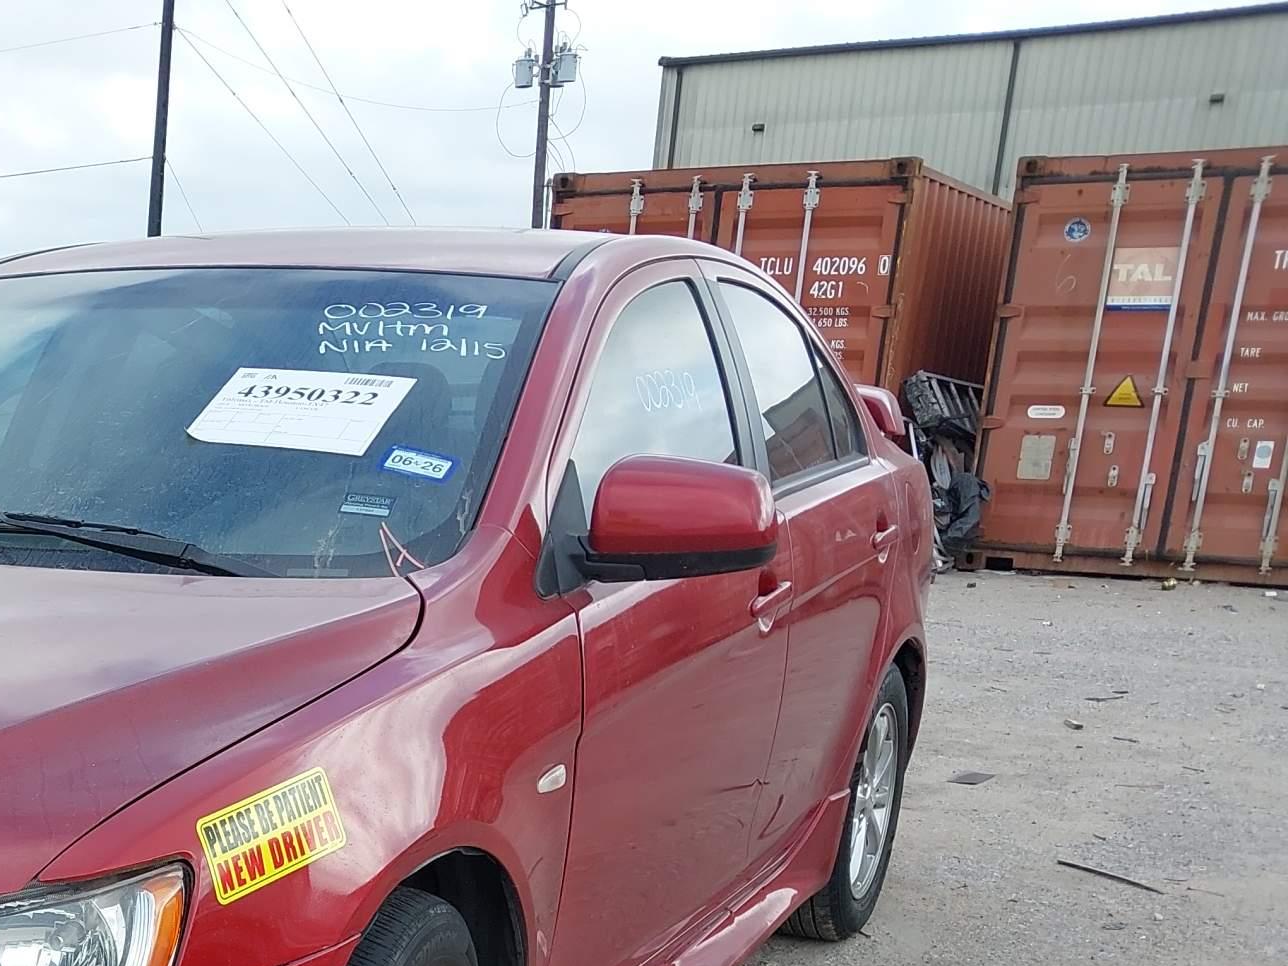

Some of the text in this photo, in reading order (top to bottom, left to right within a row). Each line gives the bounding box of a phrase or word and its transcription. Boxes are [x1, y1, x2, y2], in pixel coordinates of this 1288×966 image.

[760, 257, 793, 275] TCLU
[812, 257, 867, 275] 402096
[1113, 263, 1172, 282] TAL
[809, 281, 844, 299] 42G1
[324, 302, 488, 320] 002319
[834, 318, 849, 328] LBS.
[1240, 347, 1262, 358] TARE
[237, 384, 379, 406] 43950322
[1232, 383, 1249, 393] NET
[203, 775, 328, 858] PLEASE BE PATIENT
[216, 809, 340, 896] NEW DRIVER
